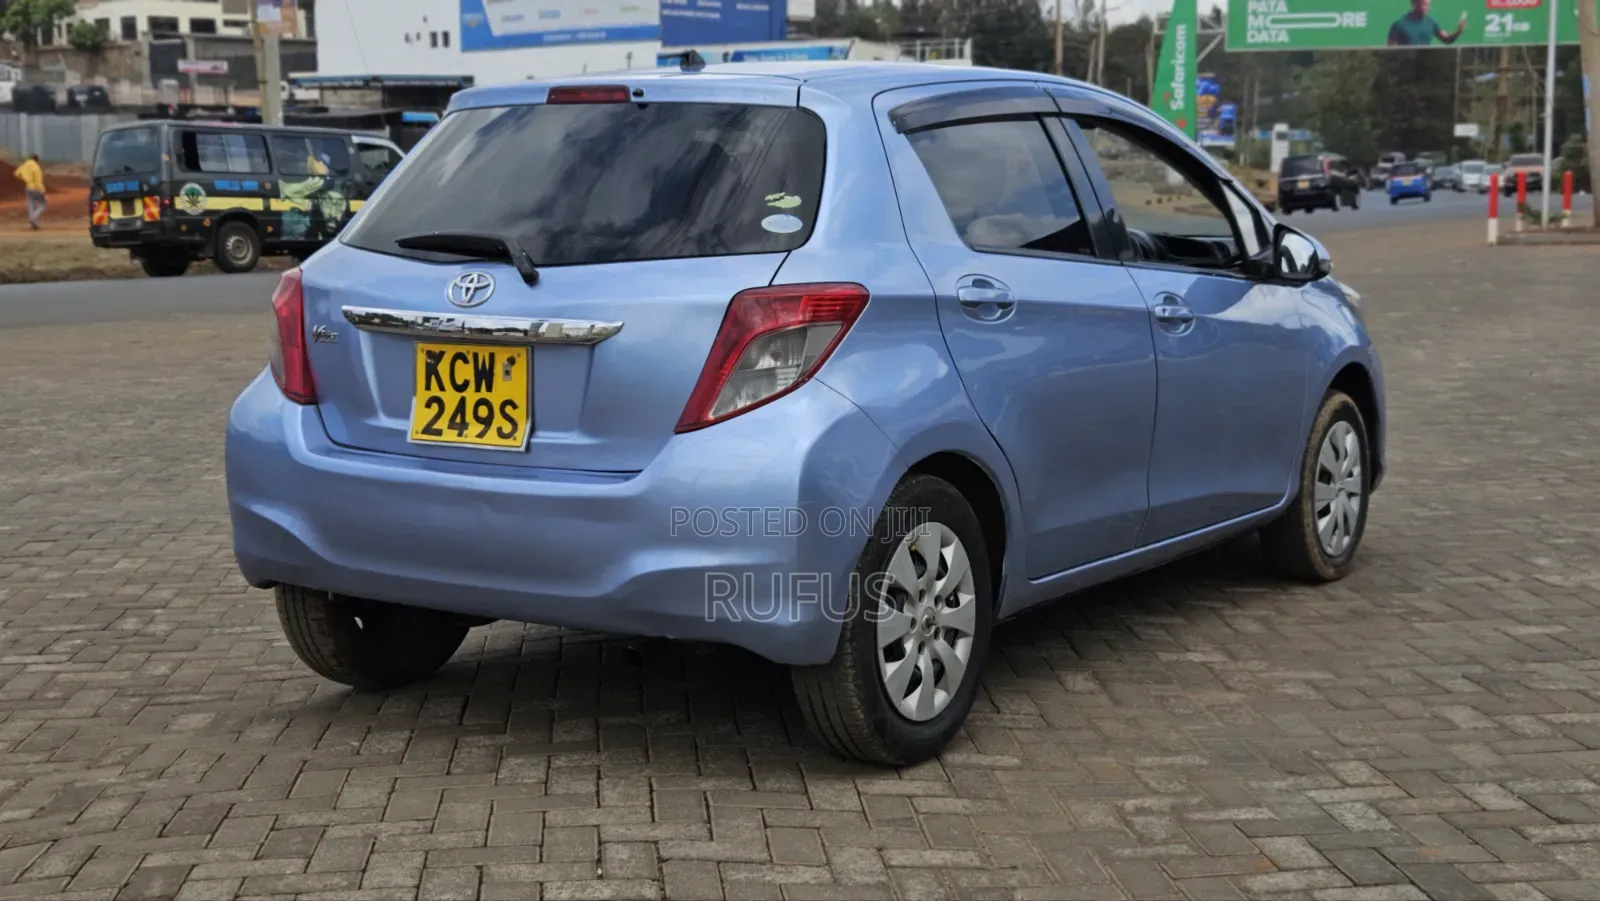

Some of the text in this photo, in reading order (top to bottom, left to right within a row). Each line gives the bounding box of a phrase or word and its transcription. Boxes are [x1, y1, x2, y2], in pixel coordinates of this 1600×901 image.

[1247, 0, 1288, 13] PATA
[1247, 30, 1290, 43] DATA
[1170, 24, 1188, 110] Safaricom
[424, 349, 496, 393] KCW
[421, 395, 520, 440] 249S
